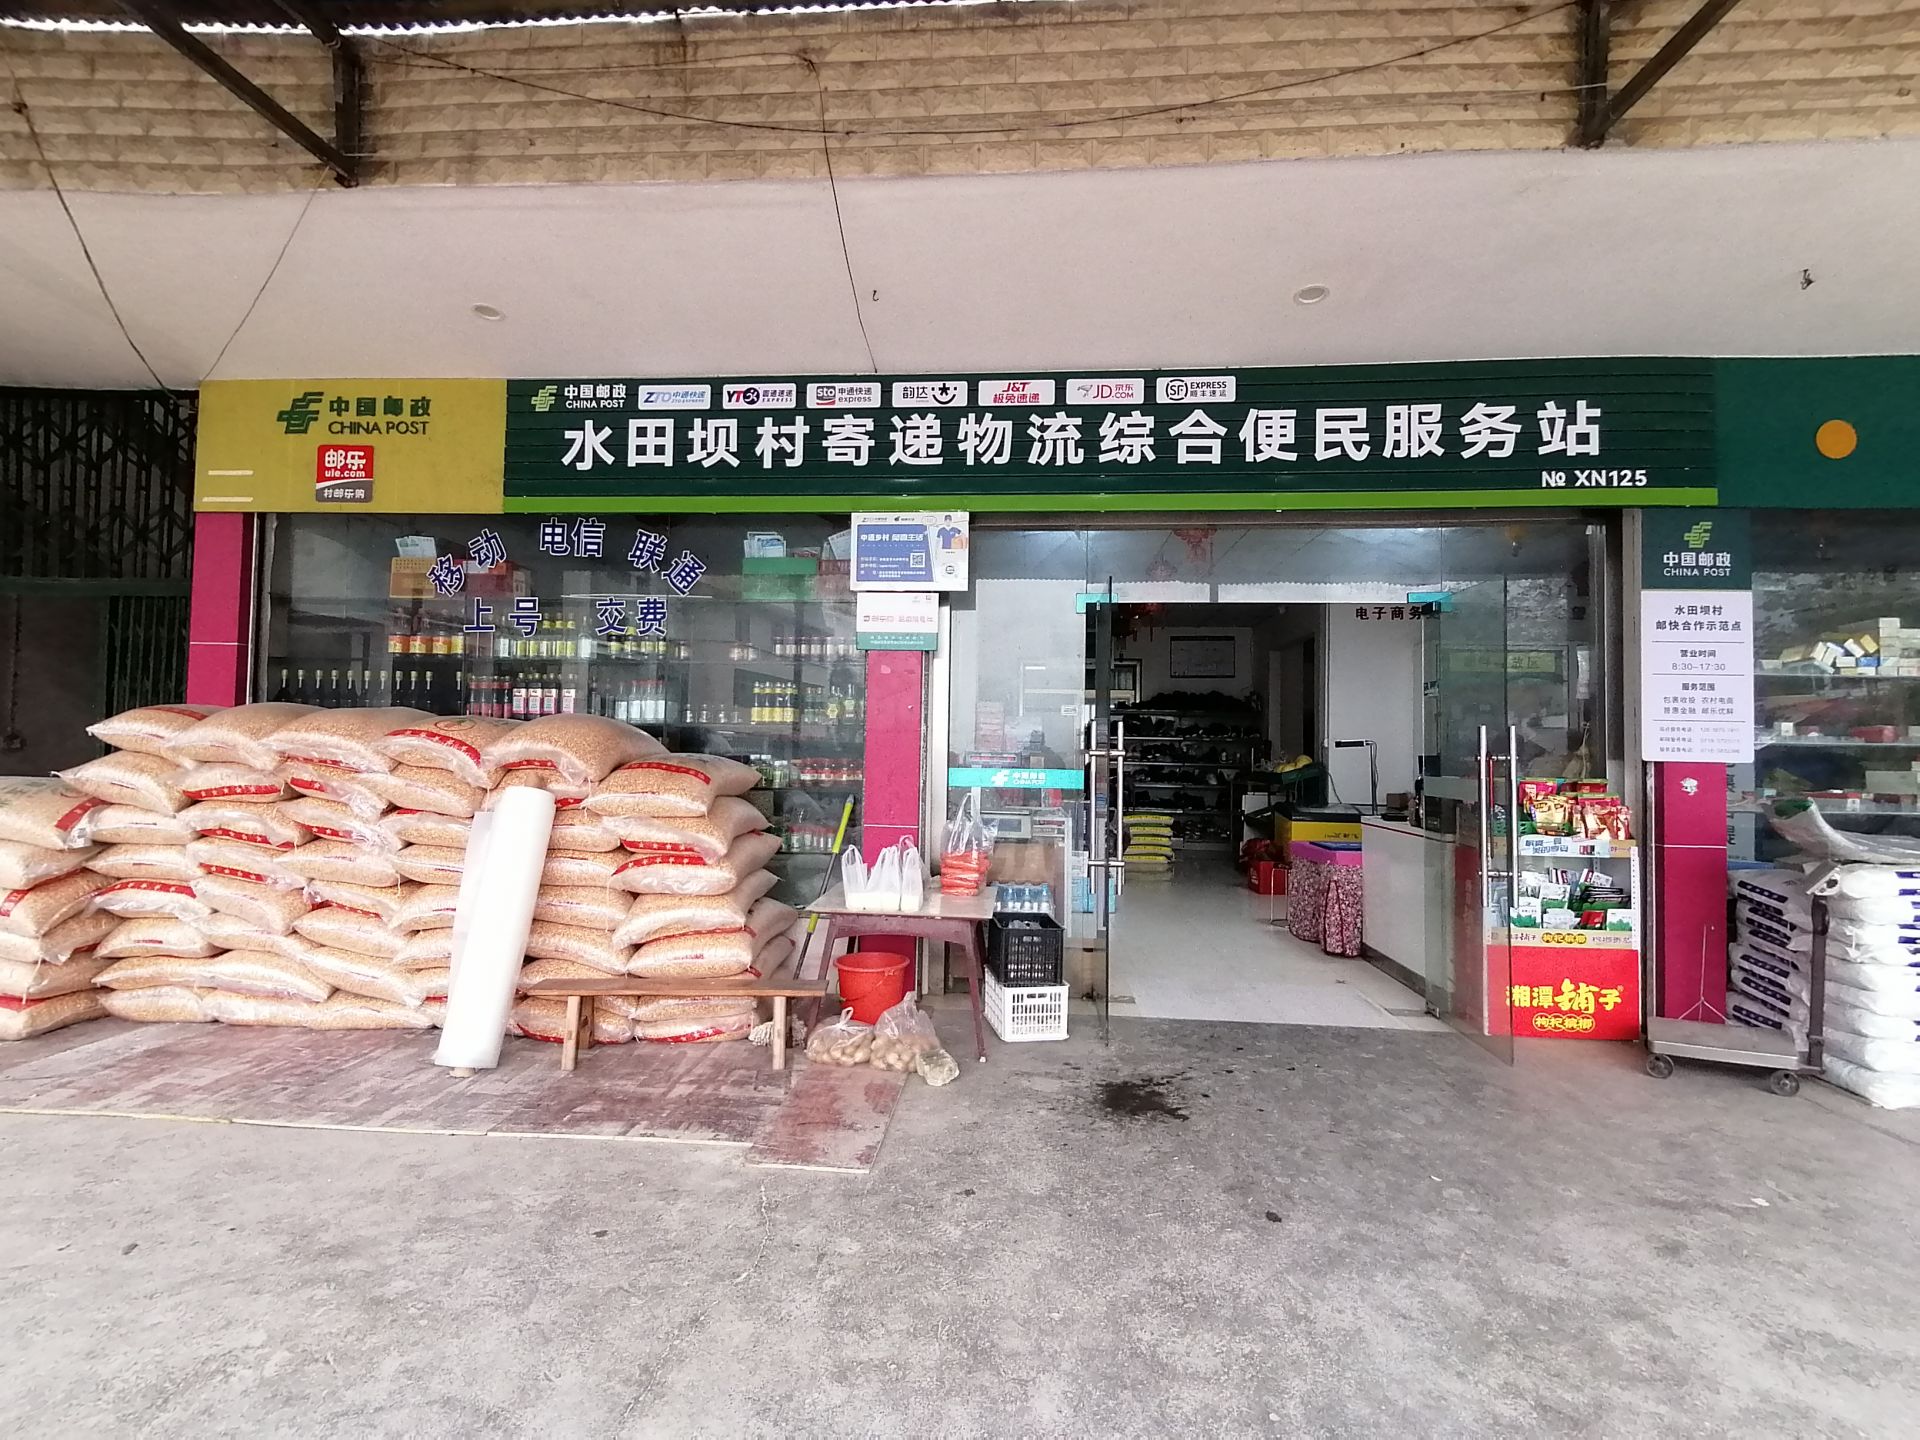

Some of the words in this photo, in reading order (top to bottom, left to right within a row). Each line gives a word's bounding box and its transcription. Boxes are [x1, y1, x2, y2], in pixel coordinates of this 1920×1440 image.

[564, 383, 627, 399] 中国邮政
[1002, 382, 1032, 392] J&T
[1190, 381, 1227, 390] EXPRESS
[838, 387, 872, 396] 申通快递
[902, 386, 928, 399] 韵达
[565, 400, 598, 409] CHINA
[600, 399, 625, 408] POST
[838, 395, 872, 403] express
[993, 393, 1040, 404] 极兔速递
[329, 395, 432, 416] 中国邮政
[328, 421, 382, 435] CHINA
[386, 421, 430, 435] POST
[561, 399, 1601, 471] 水田坝村寄递物流综合便民服务站
[324, 448, 366, 470] 邮乐
[325, 469, 365, 478] ule.com
[1574, 469, 1647, 487] XN125
[323, 488, 365, 499] 村邮乐购
[427, 528, 507, 597] 移动
[539, 517, 606, 558] 电信
[627, 528, 707, 597] 联通
[1663, 551, 1731, 567] 中国邮政
[1663, 568, 1699, 576] CHINA
[1703, 568, 1731, 577] POST
[1674, 605, 1723, 616] 水田坝村
[463, 596, 543, 638] 上号
[595, 595, 668, 638] 交费
[1655, 620, 1742, 631] 邮快合作示范点
[1680, 649, 1717, 658] 营业时间
[1681, 683, 1716, 691] 服务范围
